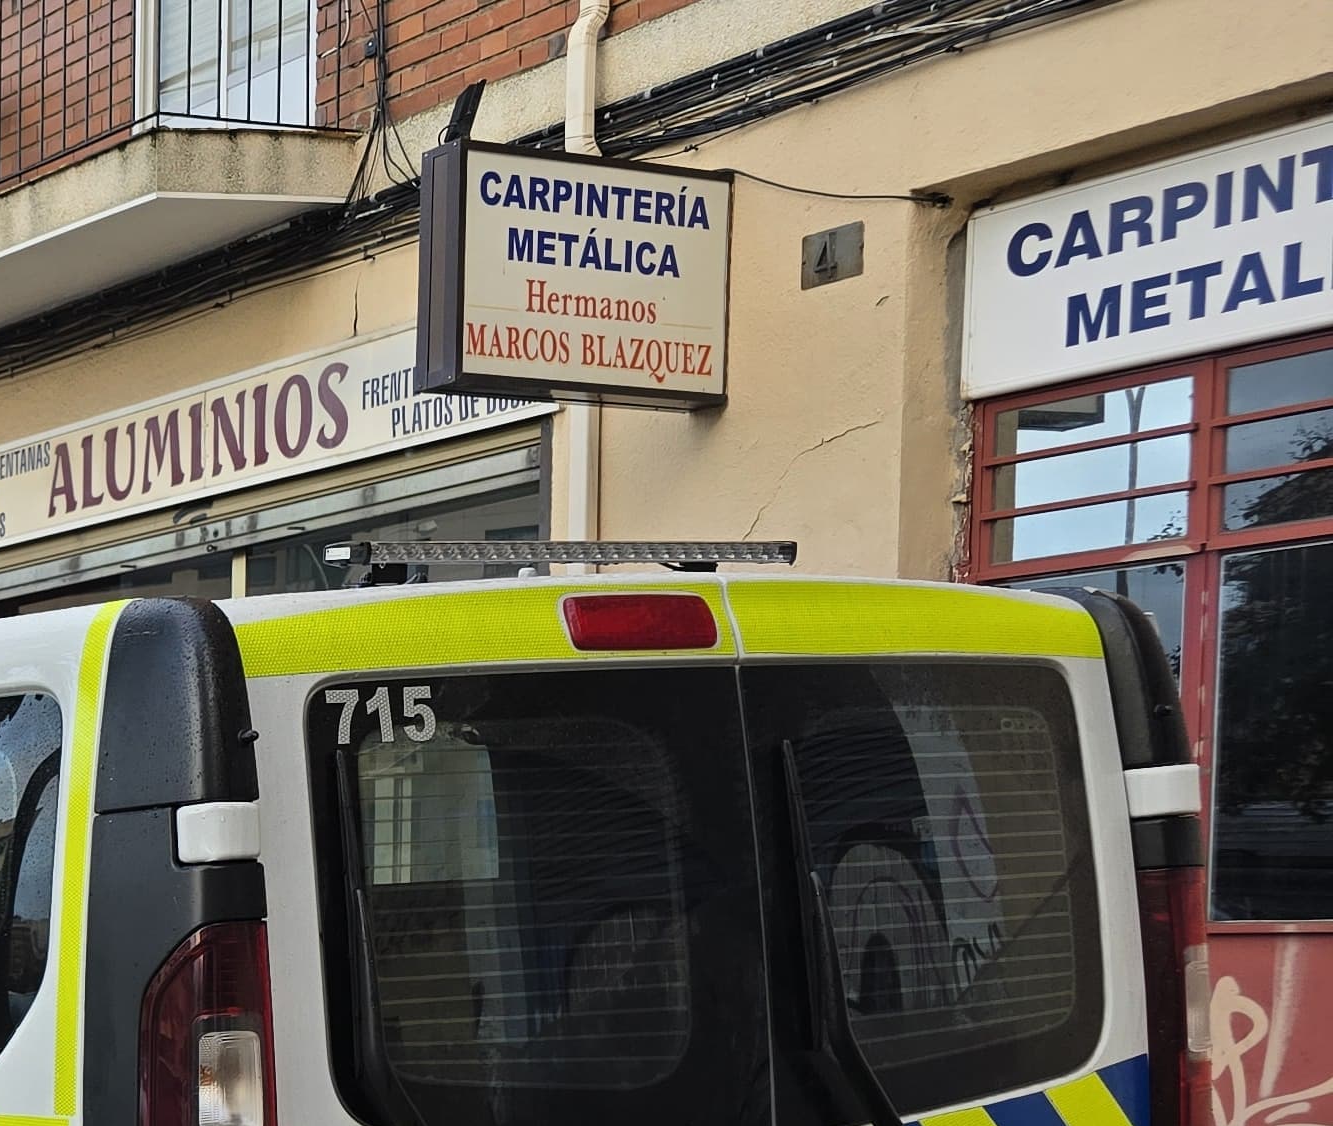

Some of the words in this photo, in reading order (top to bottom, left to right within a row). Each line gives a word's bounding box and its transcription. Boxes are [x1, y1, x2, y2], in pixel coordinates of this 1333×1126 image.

[479, 171, 710, 230] CARPINTERÍA
[507, 228, 680, 278] METÁLICA
[814, 231, 838, 280] 4
[525, 279, 657, 324] Hermanos
[1065, 242, 1333, 347] METAL
[466, 323, 569, 365] MARCOS
[581, 333, 713, 383] BLAZQUEZ
[362, 367, 416, 410] FRENT
[47, 362, 350, 518] ALUMINIOS
[392, 394, 453, 438] PLATOS
[325, 685, 436, 744] 715
